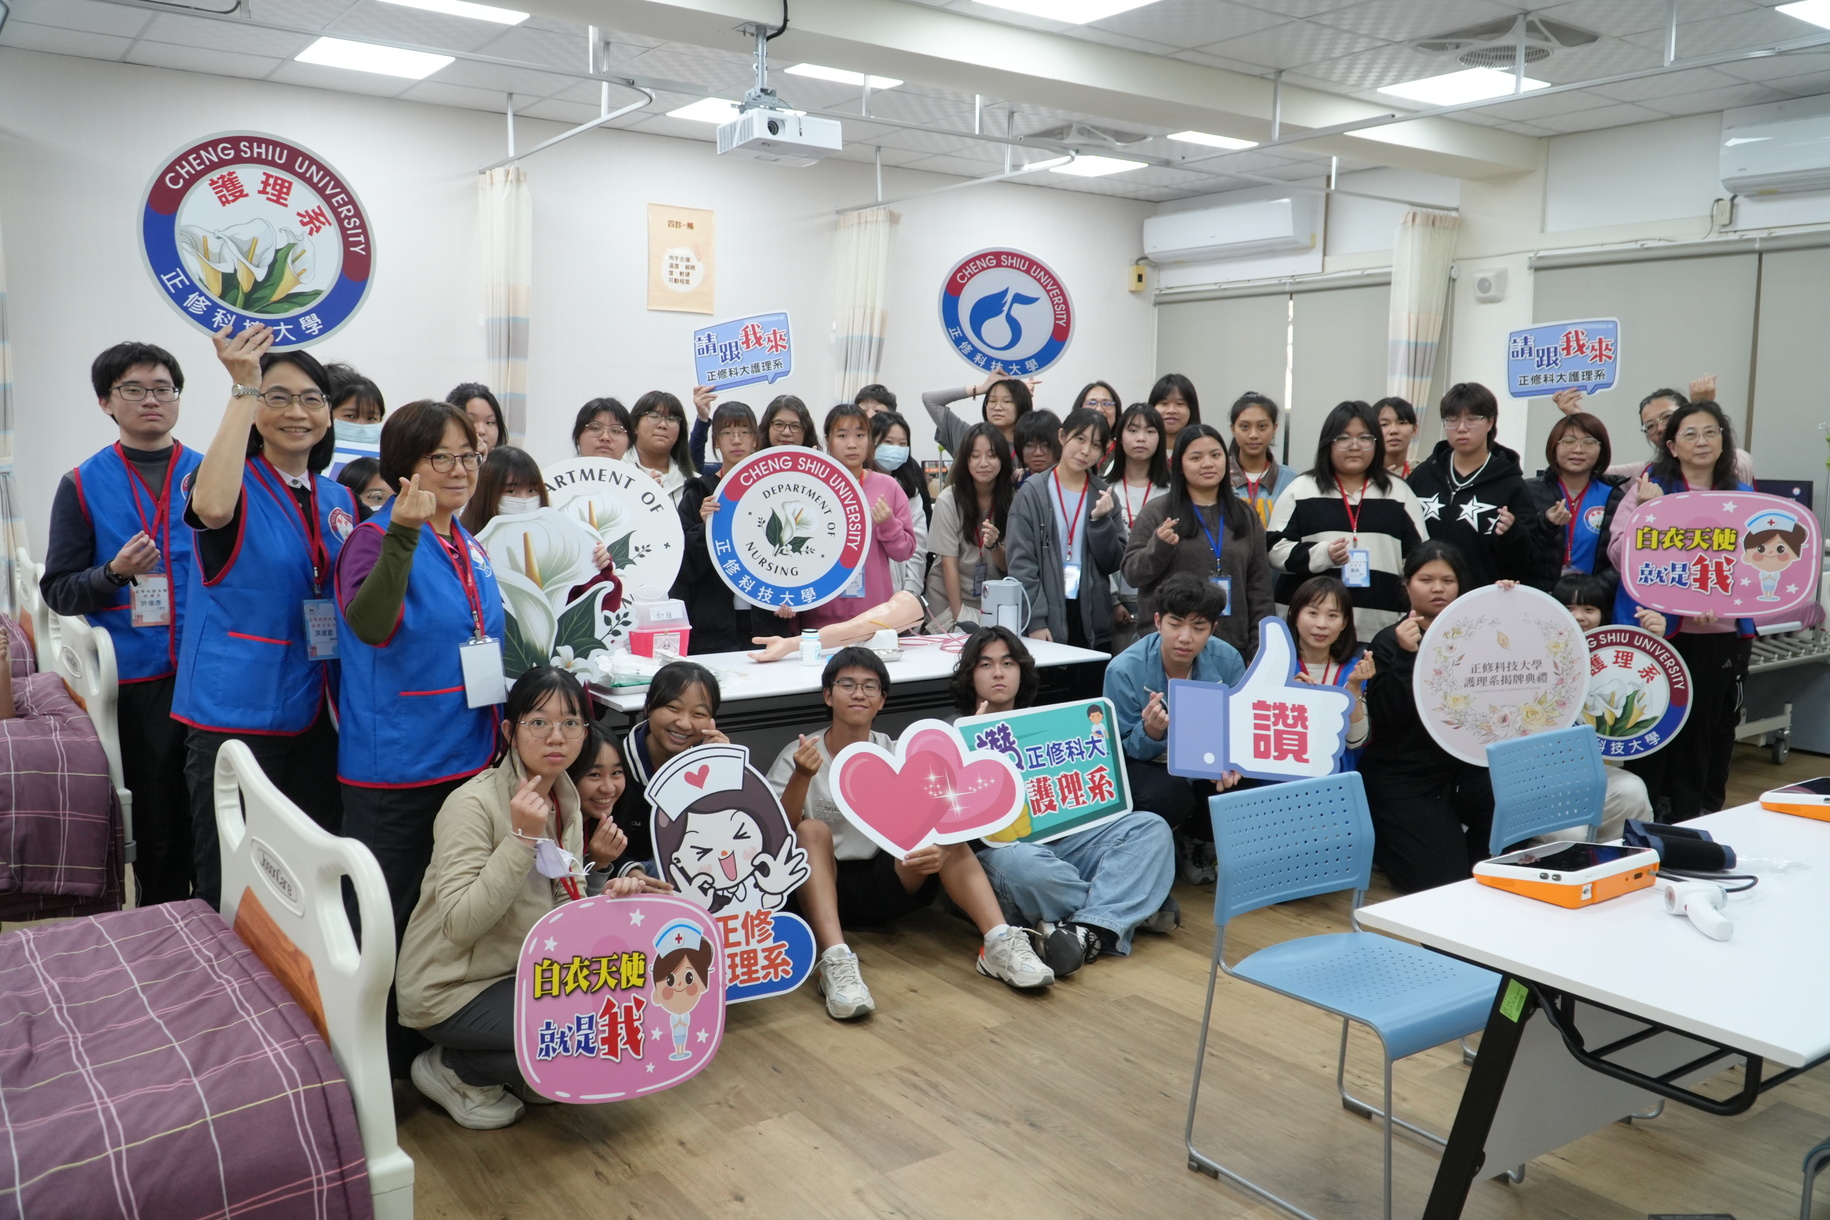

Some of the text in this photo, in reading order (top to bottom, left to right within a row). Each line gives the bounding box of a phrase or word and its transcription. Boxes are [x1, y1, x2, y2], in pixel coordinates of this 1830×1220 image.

[165, 141, 366, 256] CHENG SHIU UNIVERSITY
[209, 171, 333, 237] 護理系
[956, 255, 1067, 327] CHENG SHIU UNIVERSITY
[696, 323, 787, 363] 請跟我來
[948, 326, 1039, 375] 正修科技大學
[1511, 329, 1615, 369] 請跟我來
[706, 358, 783, 382] 正修科大護理系
[1518, 369, 1606, 386] 正修科大護理系
[641, 491, 664, 513] OF
[740, 456, 861, 551] CHENG SHIU UNIVERSITY
[762, 484, 836, 538] DEPARTMENT OF
[745, 541, 798, 577] NURSING
[1636, 526, 1737, 552] 白衣天使
[715, 539, 817, 606] 正修科技大學
[1638, 553, 1736, 595] 就是我
[1464, 672, 1548, 688] 護理系揭牌典禮
[1470, 659, 1543, 674] 正修科技大學
[1599, 632, 1685, 690] SHIU UNIVERSITY
[1025, 737, 1107, 770] 正修科大
[1252, 700, 1310, 764] 讚
[1027, 764, 1115, 817] 護理系
[716, 909, 774, 949] 正修
[533, 951, 647, 999] 白衣天使
[725, 941, 792, 985] 理系
[537, 995, 647, 1062] 就是我
